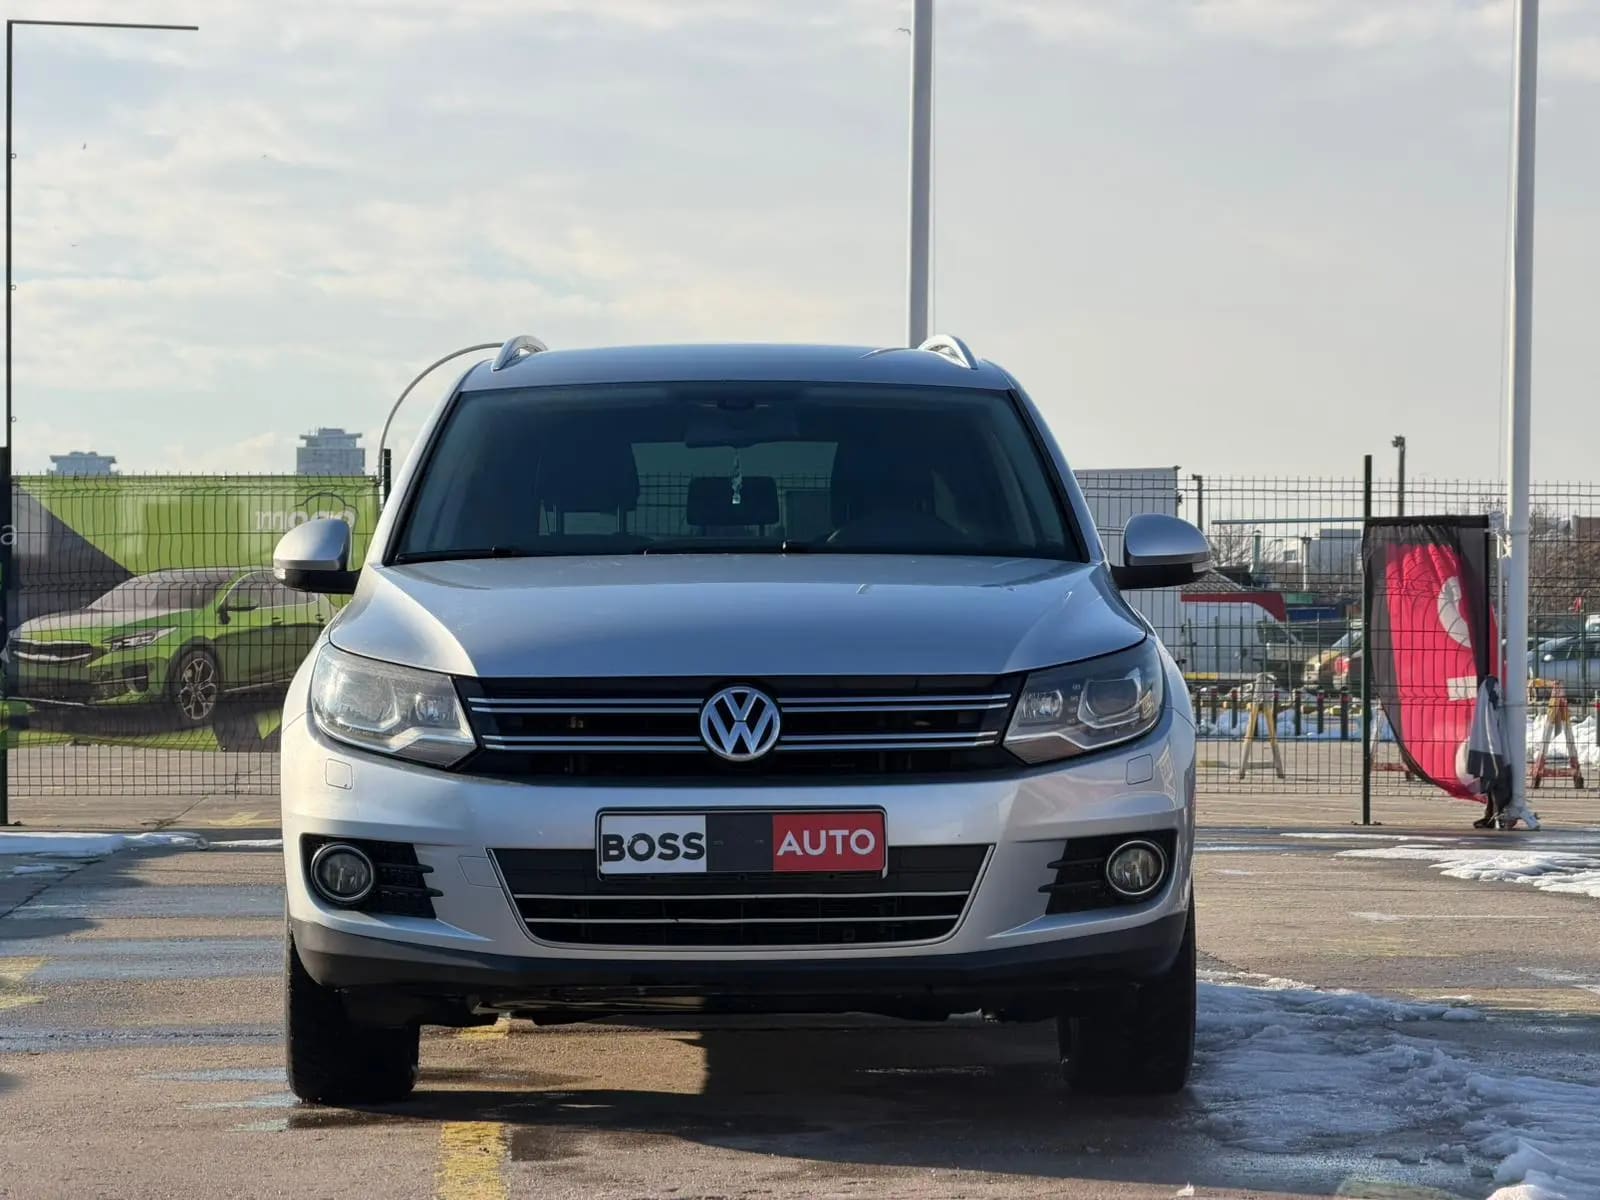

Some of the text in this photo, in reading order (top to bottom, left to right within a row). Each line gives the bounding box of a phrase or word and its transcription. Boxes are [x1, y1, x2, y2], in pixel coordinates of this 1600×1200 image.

[701, 686, 780, 761] VW
[602, 828, 876, 862] BOSS AUTO
